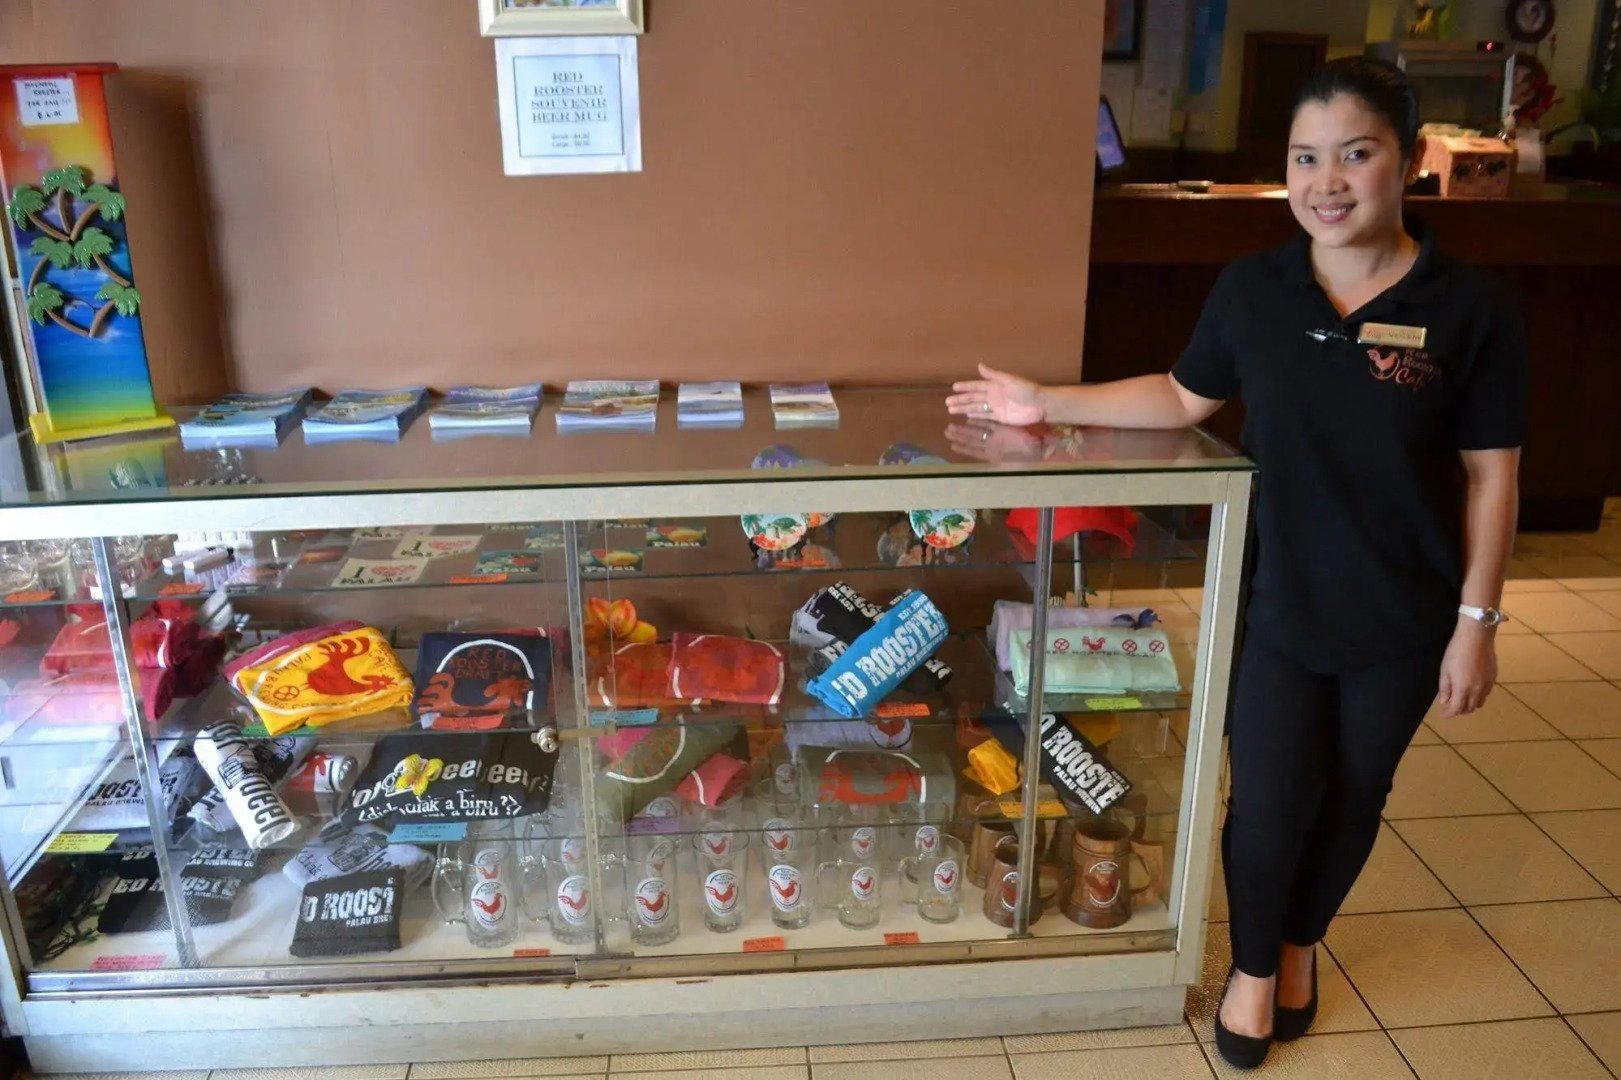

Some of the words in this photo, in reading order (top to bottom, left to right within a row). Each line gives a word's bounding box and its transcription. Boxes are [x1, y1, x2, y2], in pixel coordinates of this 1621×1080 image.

[553, 72, 583, 83] RED
[534, 85, 603, 97] ROOSTER
[531, 98, 607, 110] SOUVENIR
[533, 112, 570, 123] BEER
[574, 111, 607, 122] MUG
[346, 917, 371, 928] PALAU
